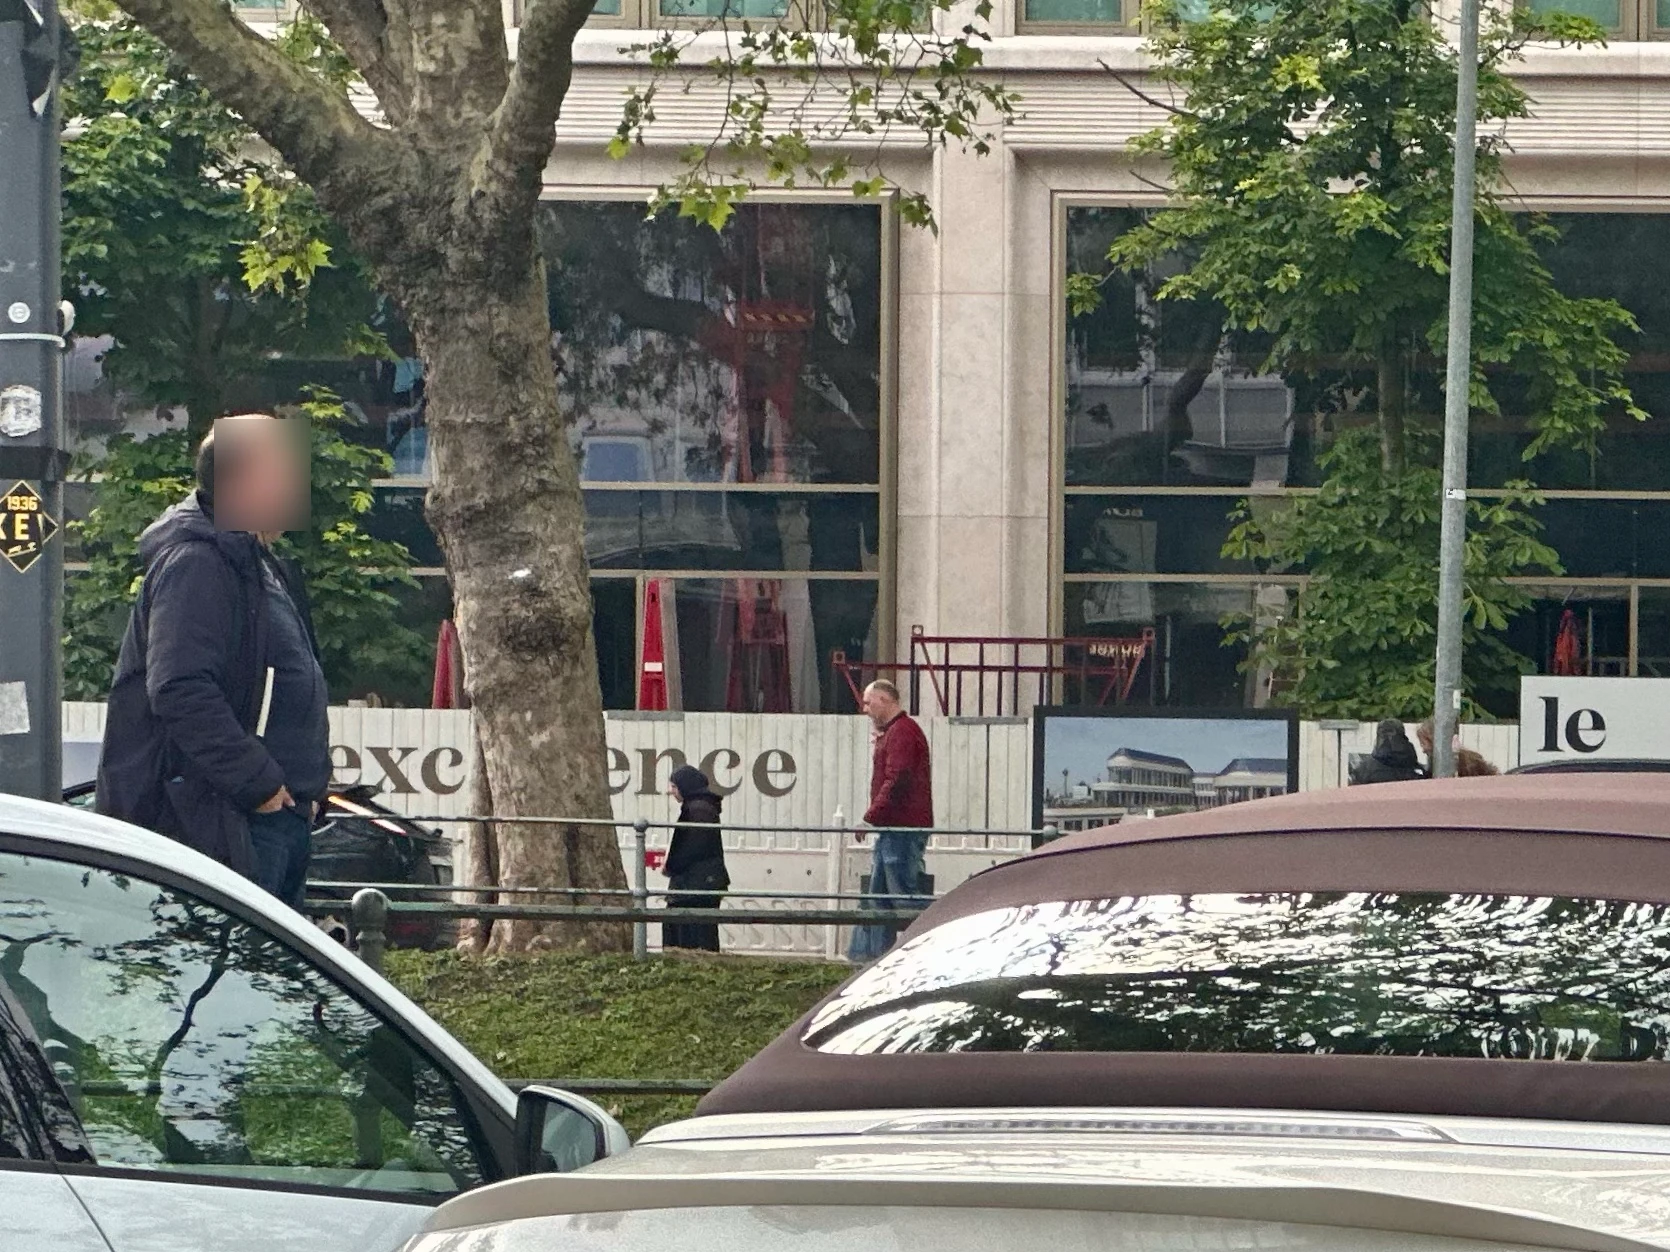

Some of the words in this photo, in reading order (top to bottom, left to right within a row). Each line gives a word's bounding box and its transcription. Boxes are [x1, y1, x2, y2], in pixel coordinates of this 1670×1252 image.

[7, 495, 38, 511] 1936
[1537, 695, 1607, 753] le
[326, 744, 798, 798] excence
